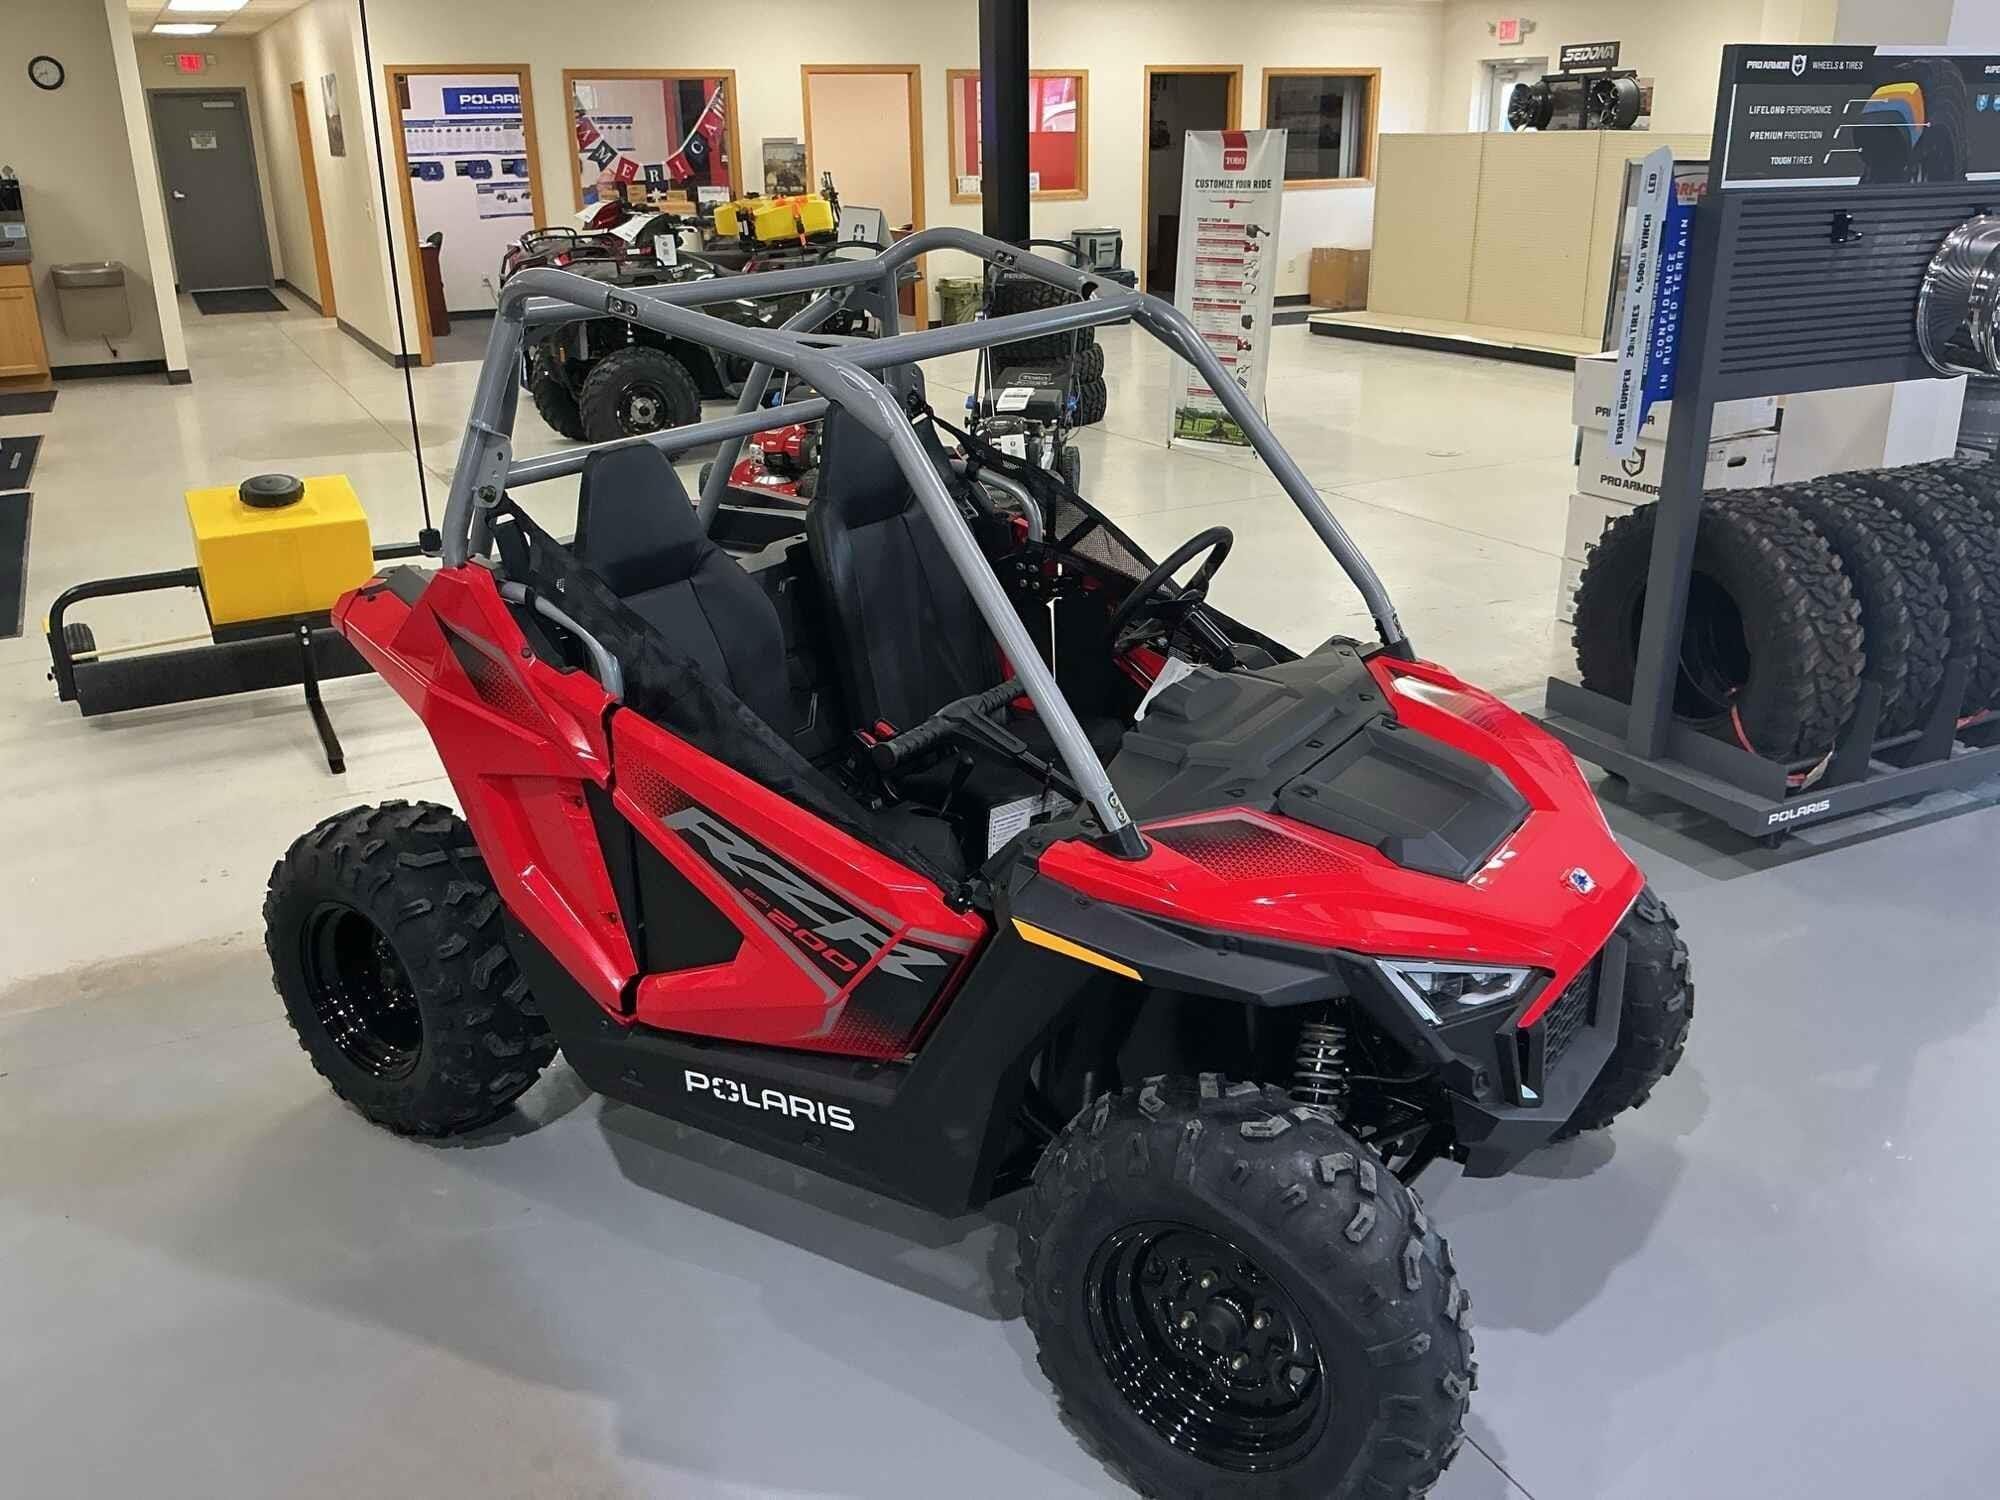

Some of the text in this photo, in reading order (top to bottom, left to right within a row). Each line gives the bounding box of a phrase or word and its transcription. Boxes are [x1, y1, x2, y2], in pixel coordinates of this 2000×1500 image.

[1561, 46, 1615, 62] SEDONA
[1812, 61, 1839, 70] WHEELS
[1845, 61, 1863, 70] TIRES
[459, 94, 521, 105] POLARI
[1749, 105, 1832, 115] LIFELONG PERFORMANCE
[1750, 131, 1823, 140] PREMIUM PROTECTION
[1225, 156, 1245, 165] TORO
[1771, 156, 1813, 165] TOUGH TIRES
[1195, 179, 1272, 189] CUSTOMIZE YOUR RIDE
[1648, 173, 1657, 194] LED
[1641, 213, 1652, 250] WINCH
[1672, 219, 1688, 291] TERRAIN
[1655, 252, 1676, 358] CONFIDENCE
[1630, 304, 1640, 334] TIRES
[1662, 302, 1678, 365] RUGGED
[1659, 374, 1669, 390] IN
[1615, 369, 1632, 445] FRONT BUMPER
[1600, 474, 1661, 497] PRO ARMOR
[1768, 800, 1830, 825] POLARIS
[767, 908, 858, 972] 200
[684, 1070, 855, 1132] POLARIS
